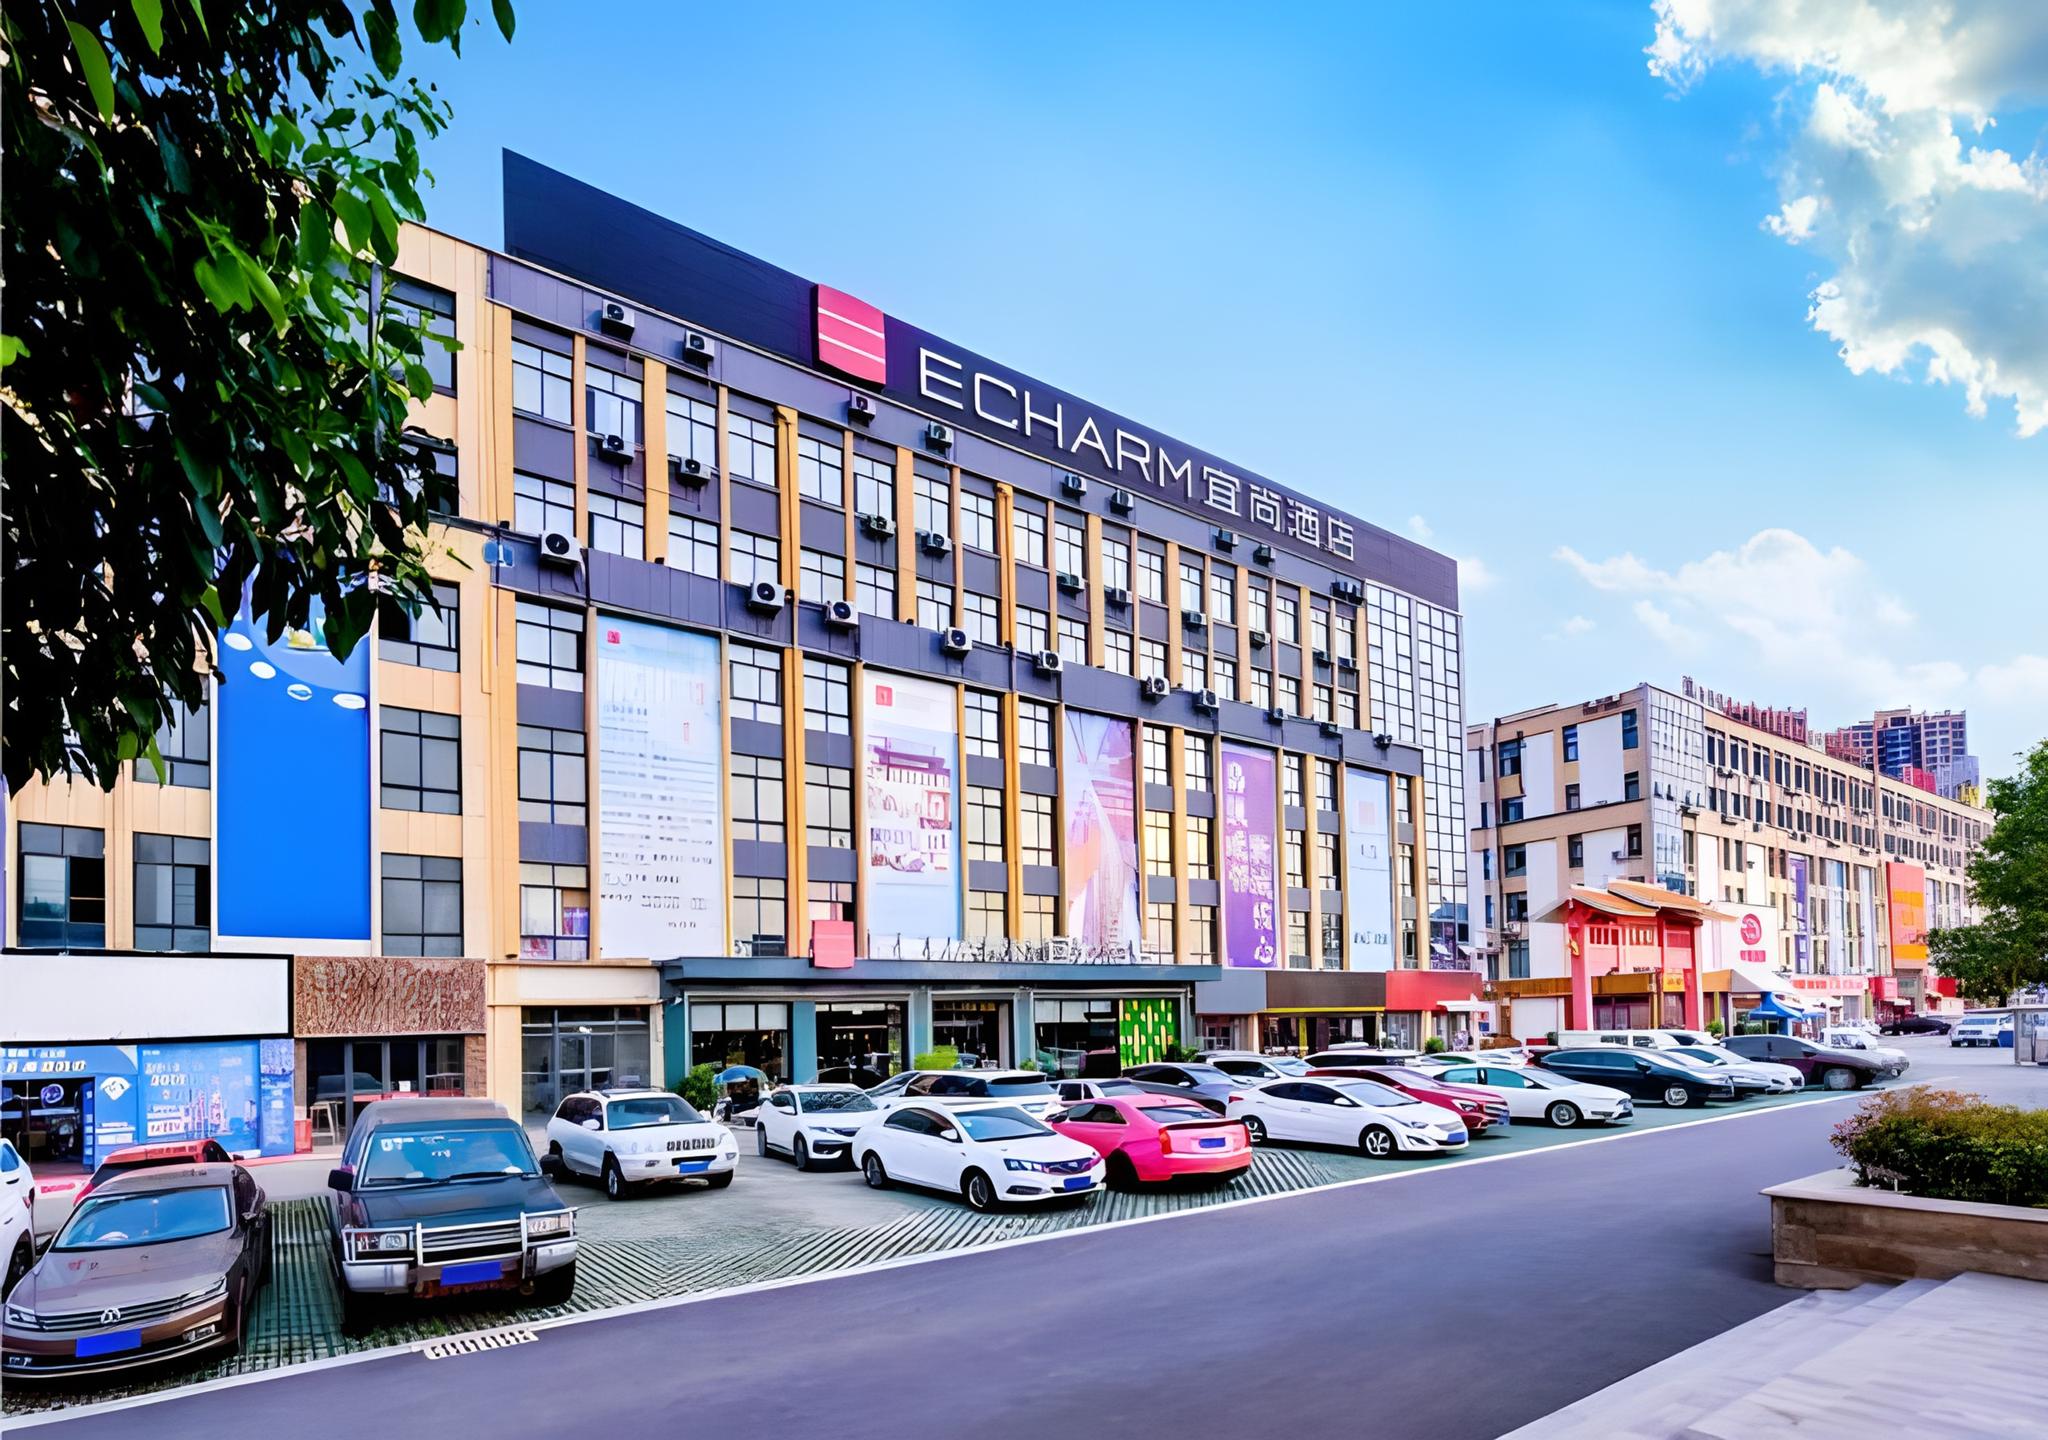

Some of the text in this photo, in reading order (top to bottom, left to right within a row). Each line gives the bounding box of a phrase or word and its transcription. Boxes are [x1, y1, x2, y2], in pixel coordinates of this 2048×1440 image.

[920, 347, 1354, 561] ECHARM 宜尚酒店
